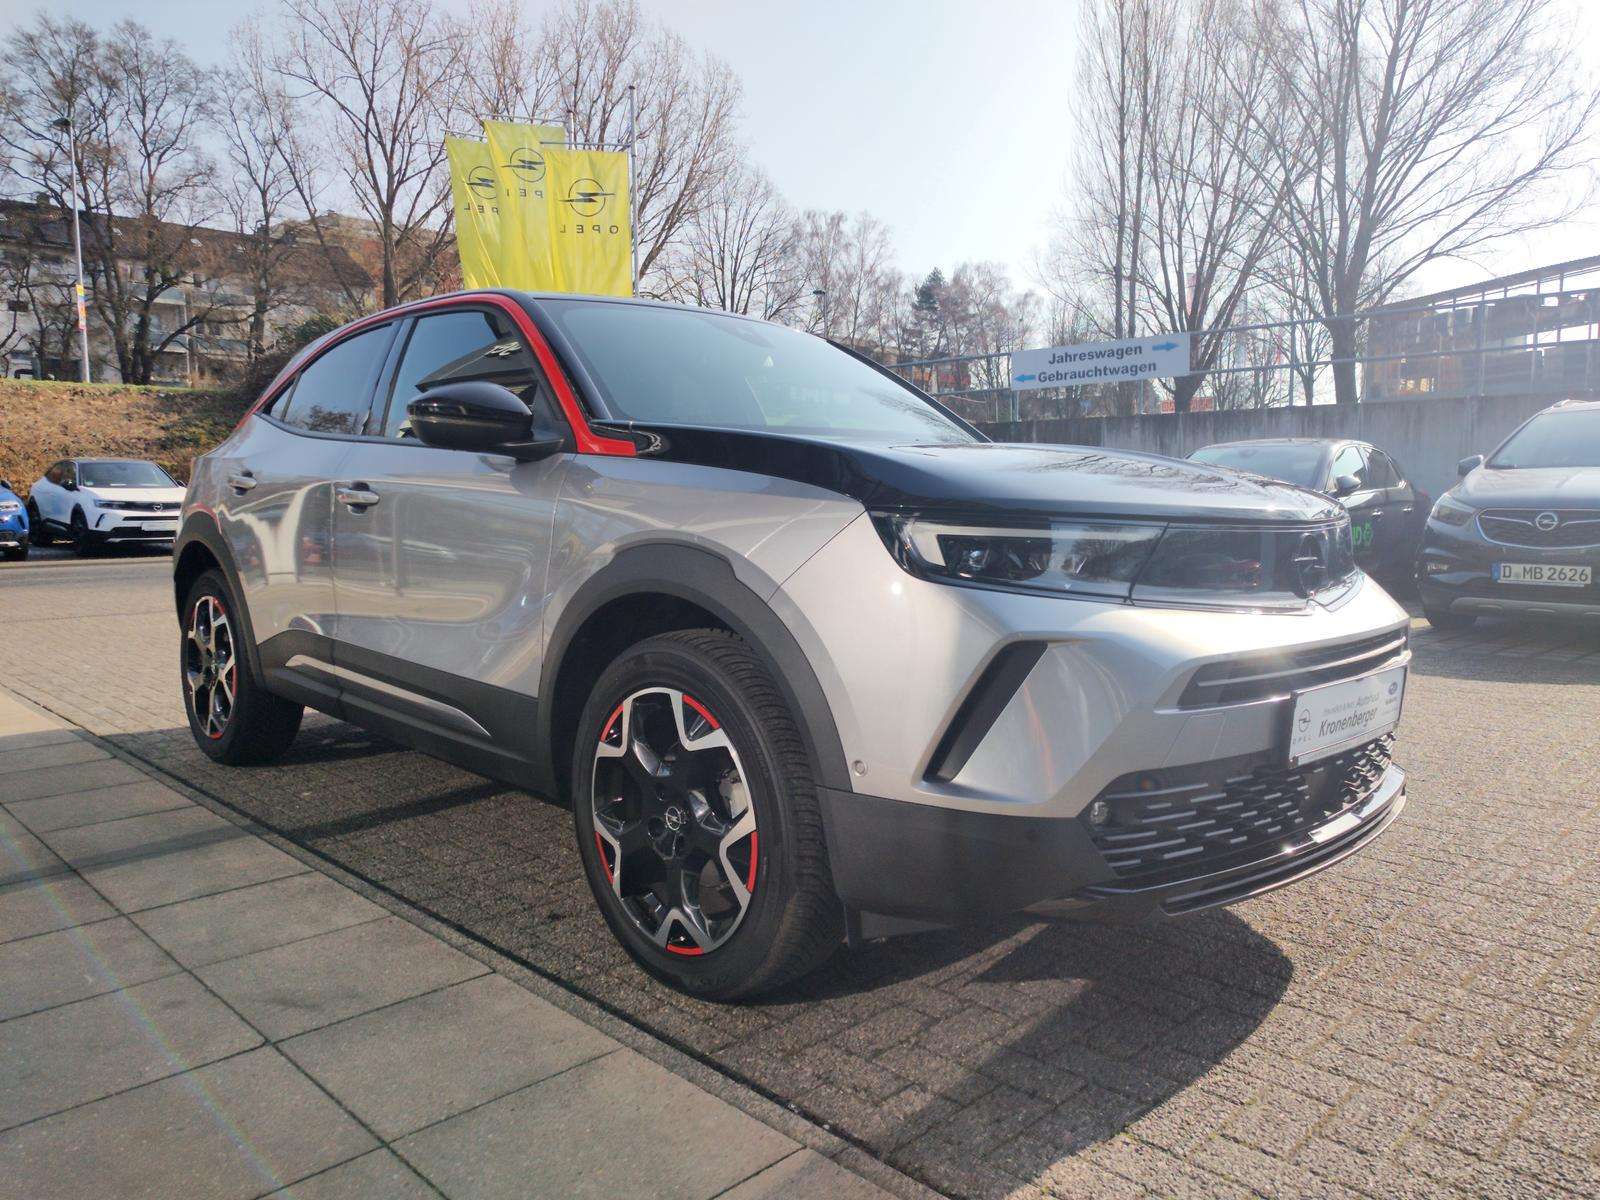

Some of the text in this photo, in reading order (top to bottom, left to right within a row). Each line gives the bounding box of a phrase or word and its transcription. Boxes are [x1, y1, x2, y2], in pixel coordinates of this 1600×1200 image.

[1048, 343, 1143, 365] Jahreswagen
[1037, 361, 1157, 383] Gebrauchtwagen
[1502, 565, 1588, 581] D MB 2626
[1318, 707, 1378, 738] Kronenberger
